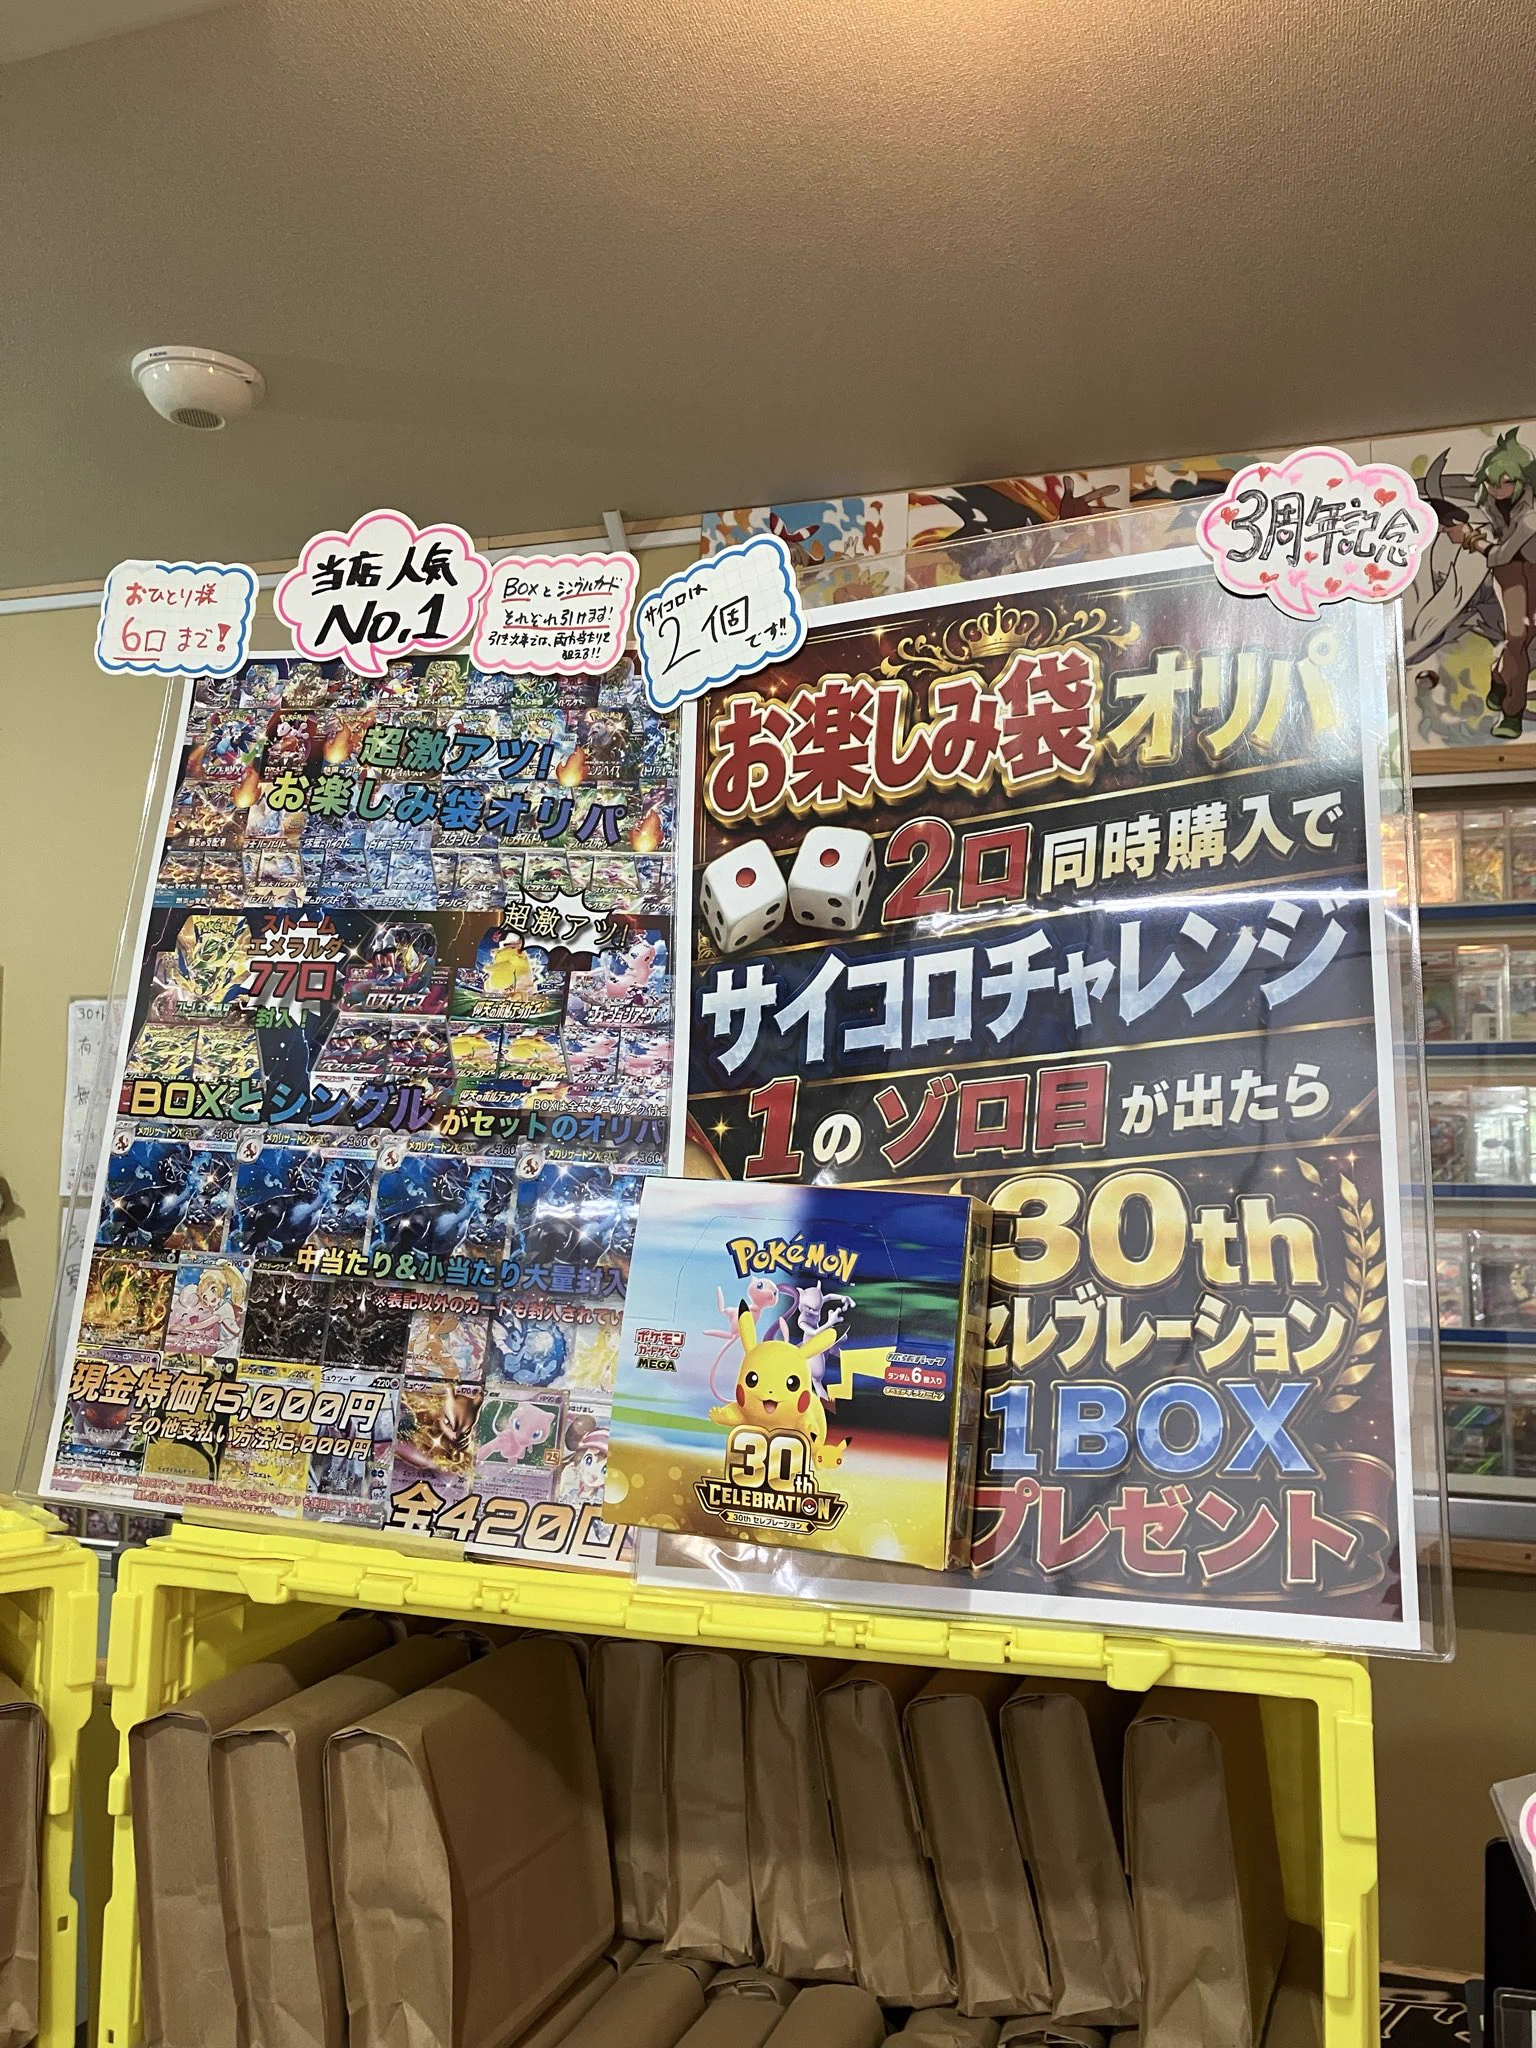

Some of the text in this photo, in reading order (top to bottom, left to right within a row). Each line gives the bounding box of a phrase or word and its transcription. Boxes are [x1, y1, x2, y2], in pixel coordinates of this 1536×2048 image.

[1226, 489, 1419, 567] 3周年記念
[312, 542, 458, 596] 当店人気
[125, 582, 218, 608] おひとり様
[644, 583, 708, 628] サイコロは
[314, 594, 449, 647] No.1
[267, 770, 628, 846] お楽しみ袋オリパ
[246, 936, 345, 960] エメラルダ
[261, 914, 337, 936] ストーム
[248, 960, 338, 1002] 77口
[701, 887, 1350, 1077] サイコロチャレンジ
[989, 1172, 1324, 1289] 30th
[636, 1328, 686, 1347] ポケモン
[637, 1344, 680, 1358] カードゲーム
[637, 1357, 677, 1371] MEGA
[989, 1381, 1316, 1474] 1BOX
[972, 1478, 1358, 1584] プレゼント
